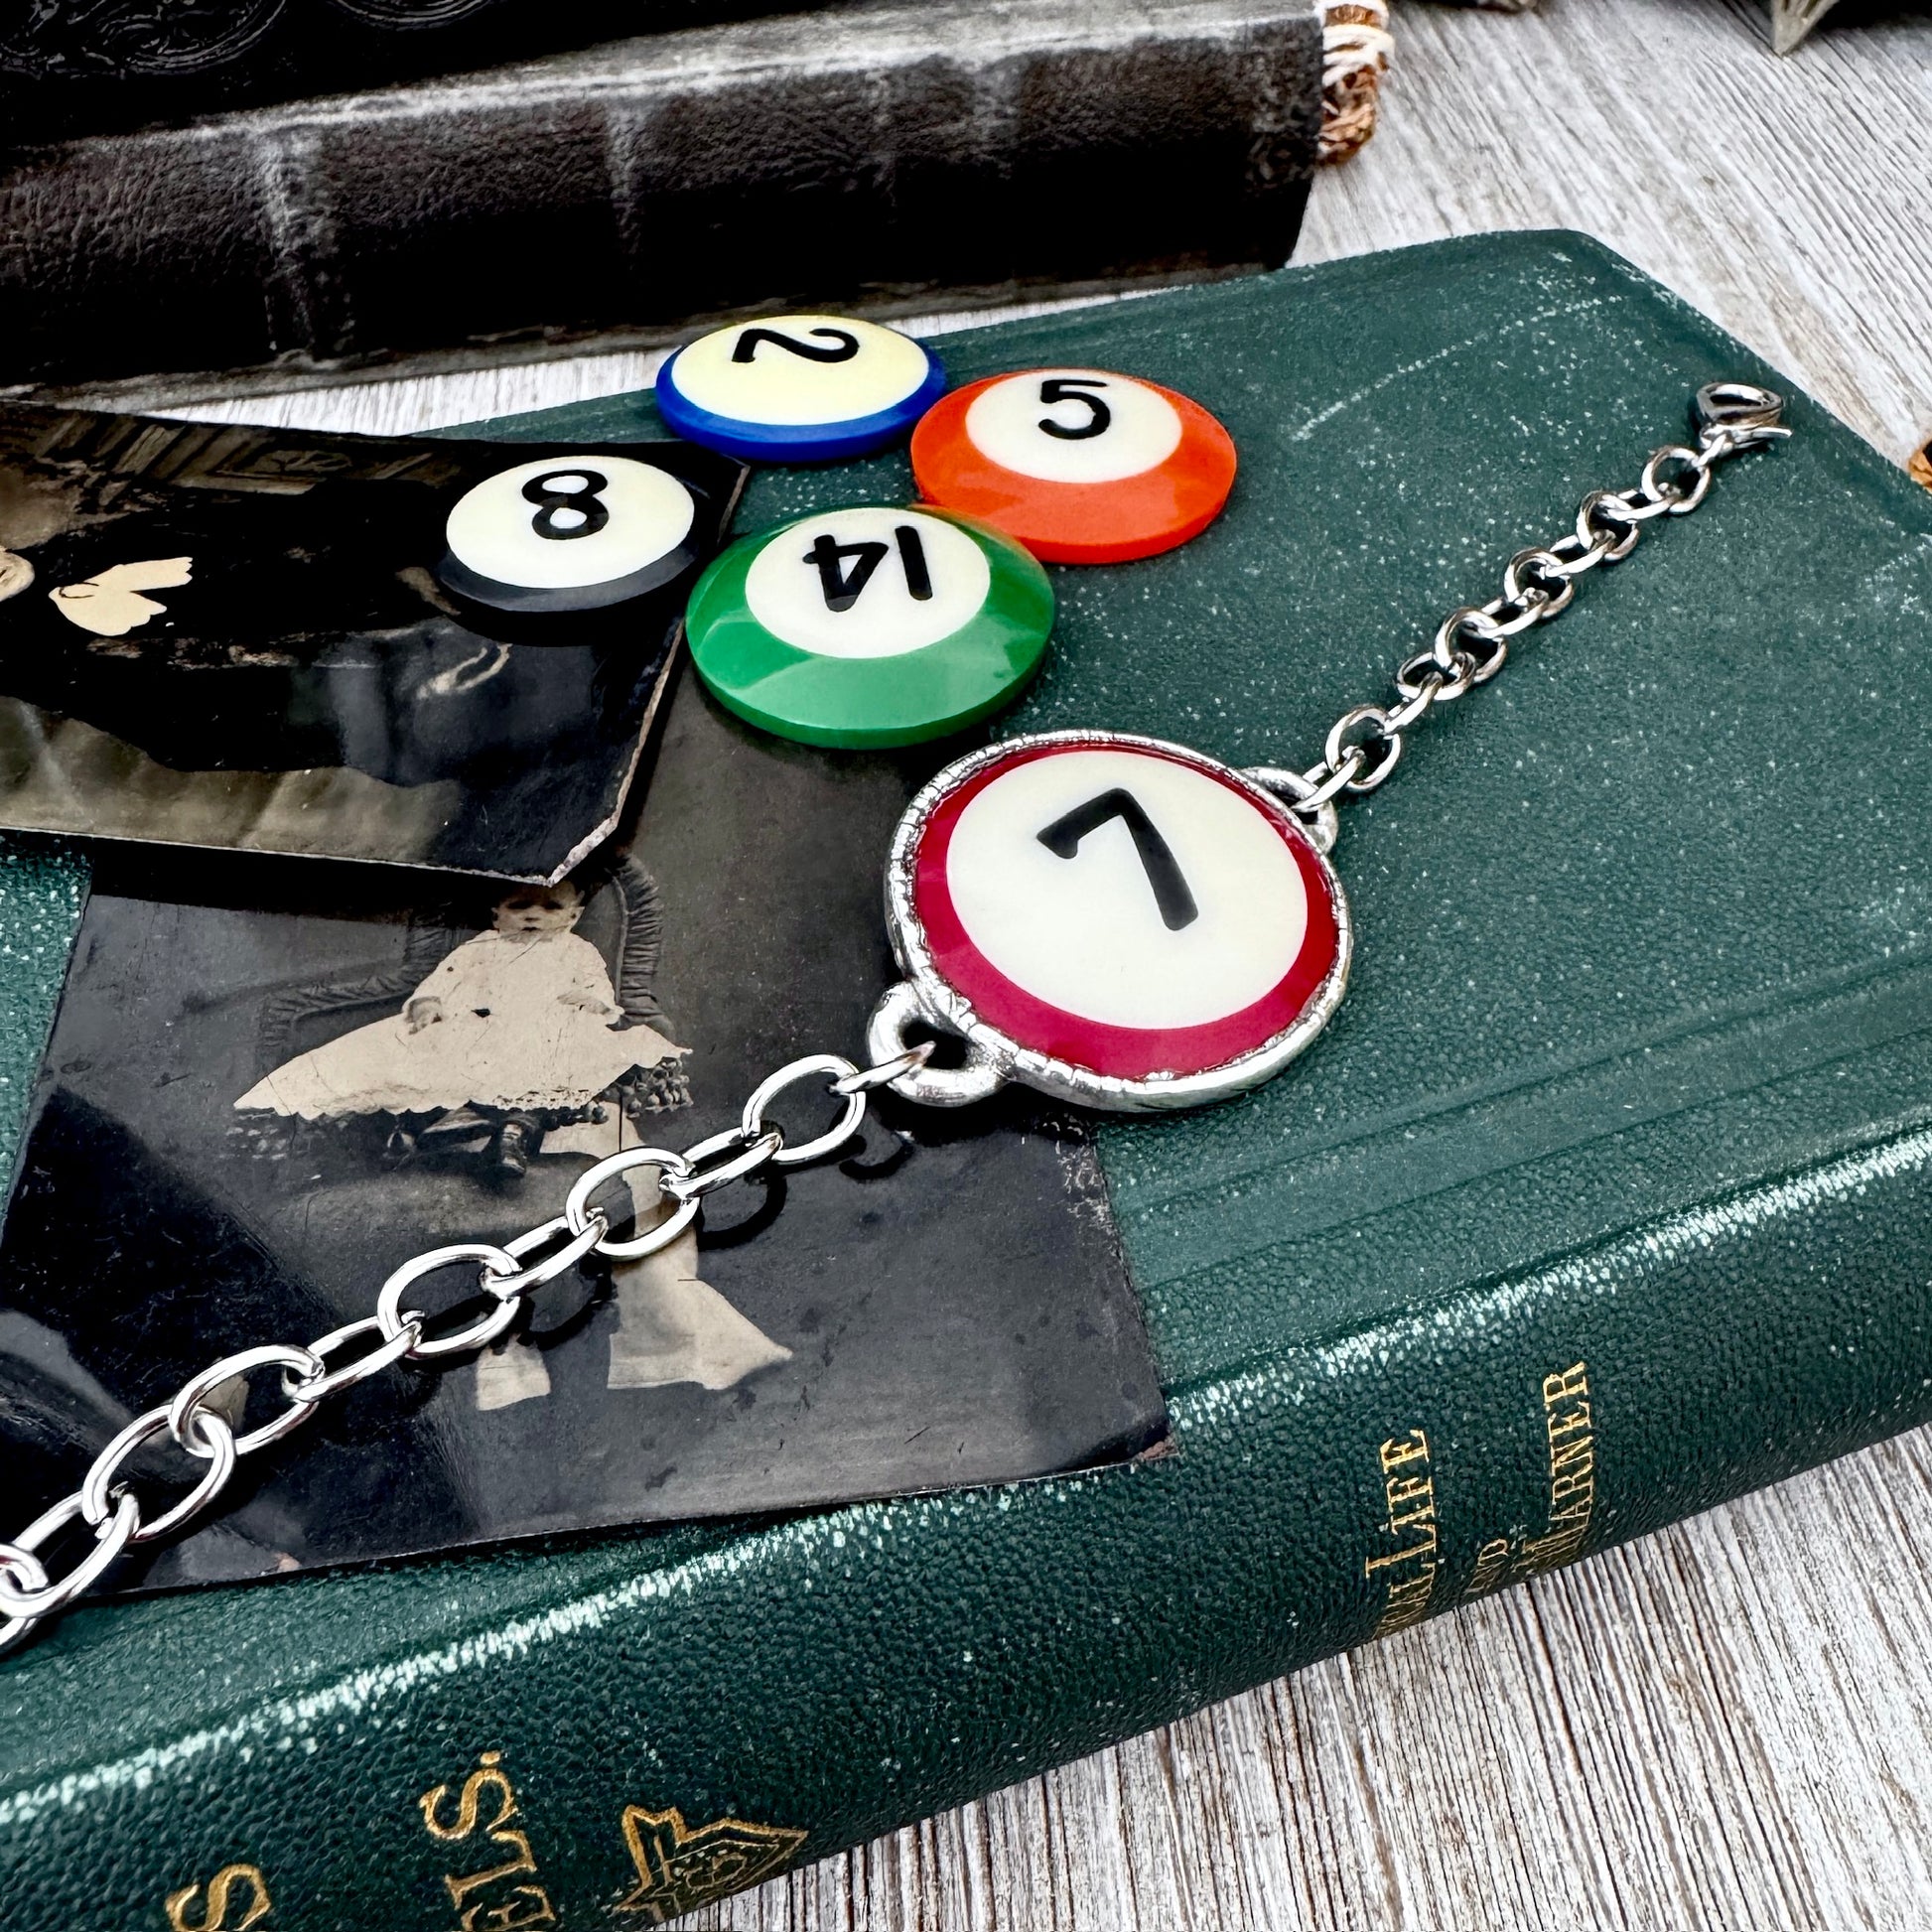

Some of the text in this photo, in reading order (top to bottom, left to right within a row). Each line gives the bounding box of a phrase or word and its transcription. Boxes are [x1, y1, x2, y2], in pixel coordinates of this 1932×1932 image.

[732, 328, 860, 363] 2
[1037, 378, 1111, 440] 5
[521, 470, 609, 540] 8
[802, 525, 934, 613] 14
[1035, 787, 1197, 931] 7
